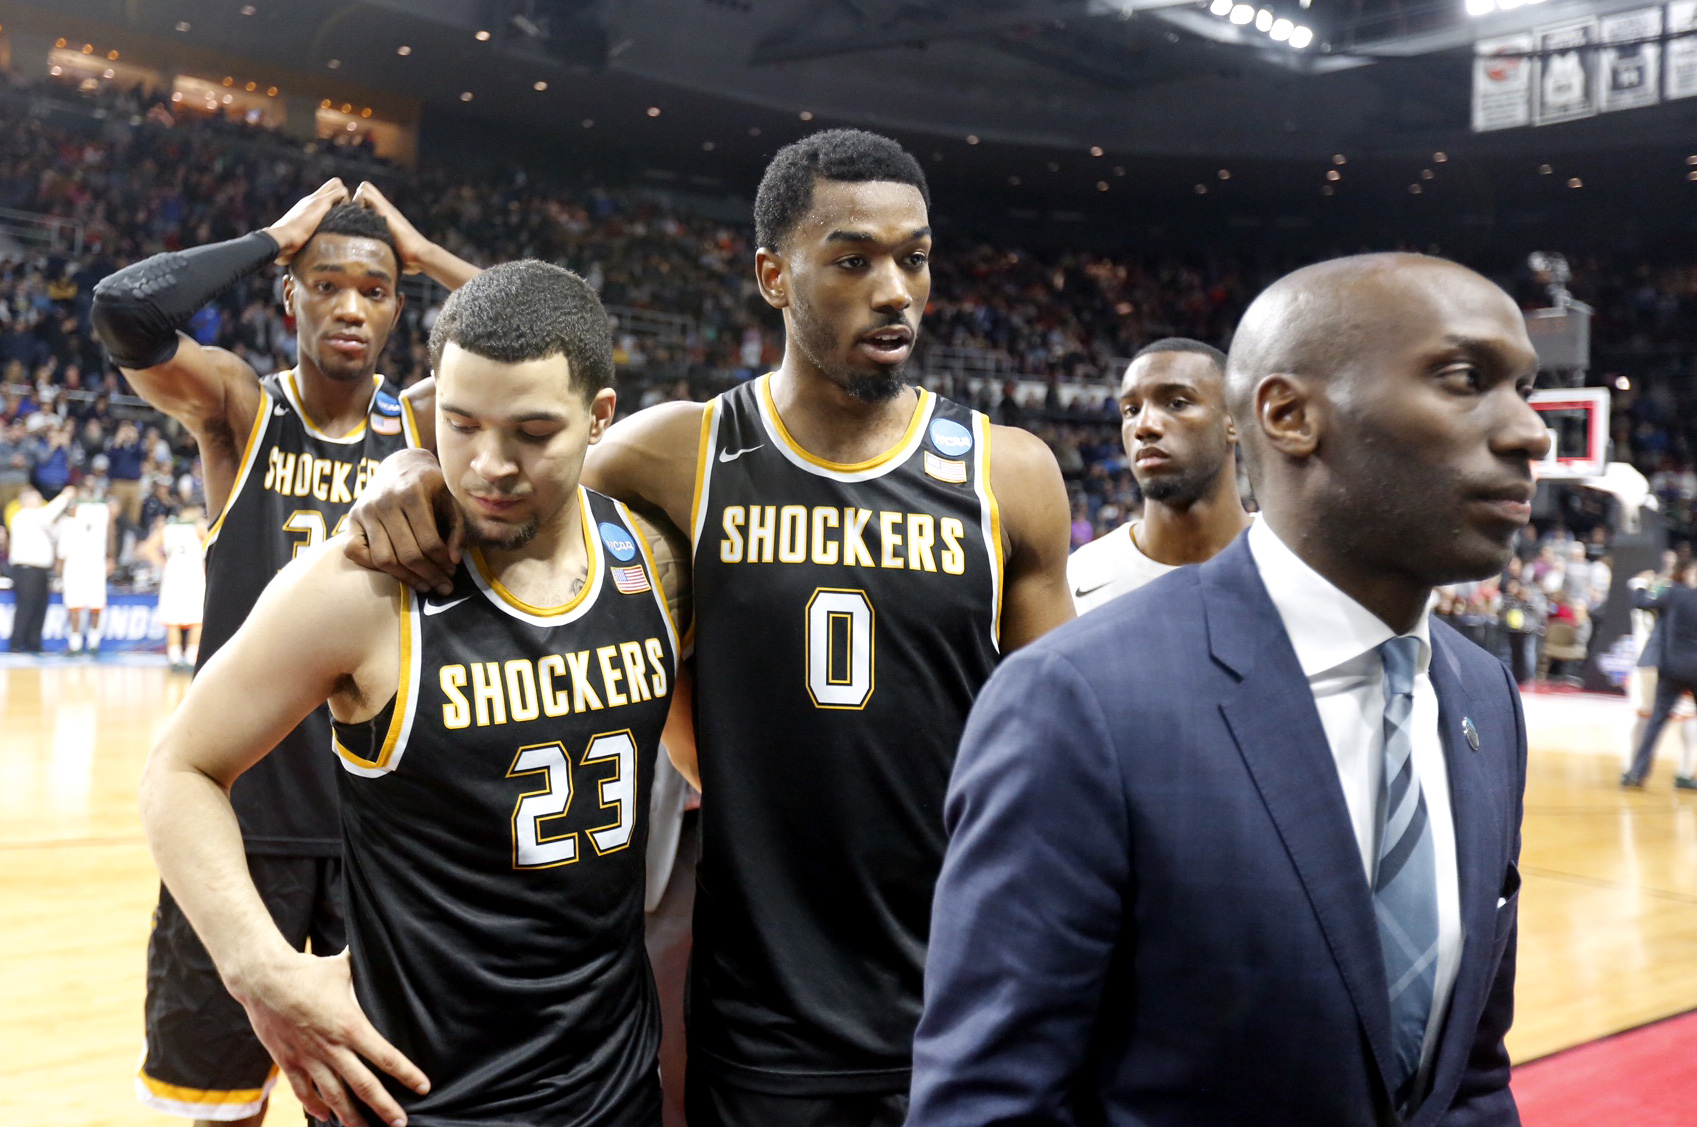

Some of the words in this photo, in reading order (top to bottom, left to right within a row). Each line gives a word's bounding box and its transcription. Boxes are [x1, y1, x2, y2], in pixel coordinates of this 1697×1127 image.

[934, 433, 972, 447] NCAA
[605, 540, 635, 551] NCAA
[720, 504, 966, 576] SHOCKERS
[438, 637, 668, 730] SHOCKERS
[804, 586, 876, 711] 0
[505, 728, 638, 870] 23
